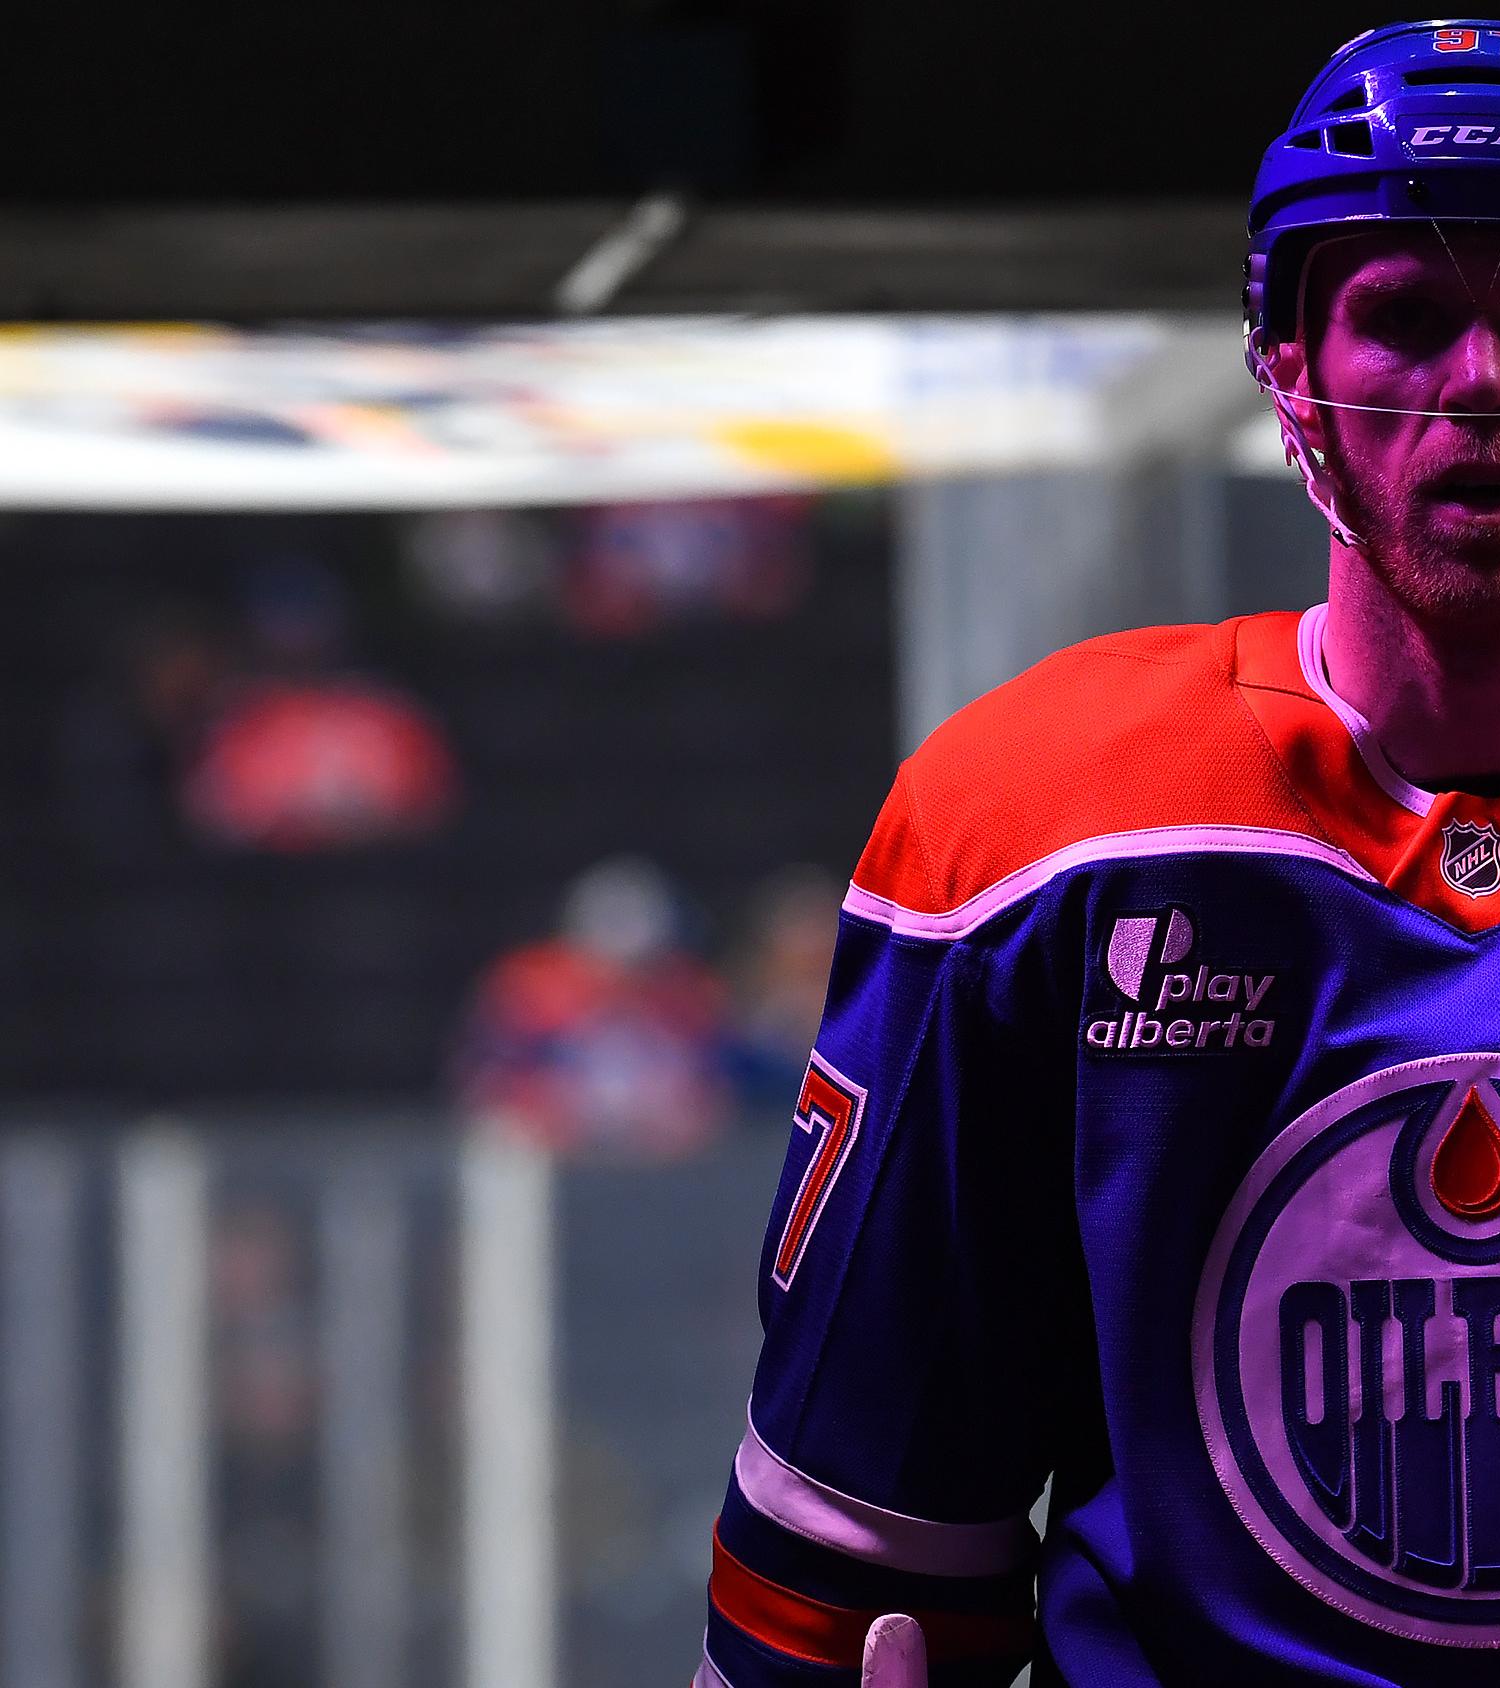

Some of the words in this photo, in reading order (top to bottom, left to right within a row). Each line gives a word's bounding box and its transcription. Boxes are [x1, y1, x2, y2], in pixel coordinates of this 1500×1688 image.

[1454, 843, 1491, 879] NHL
[1155, 965, 1276, 1011] play
[1086, 1011, 1276, 1049] alberta
[770, 1047, 869, 1293] 7
